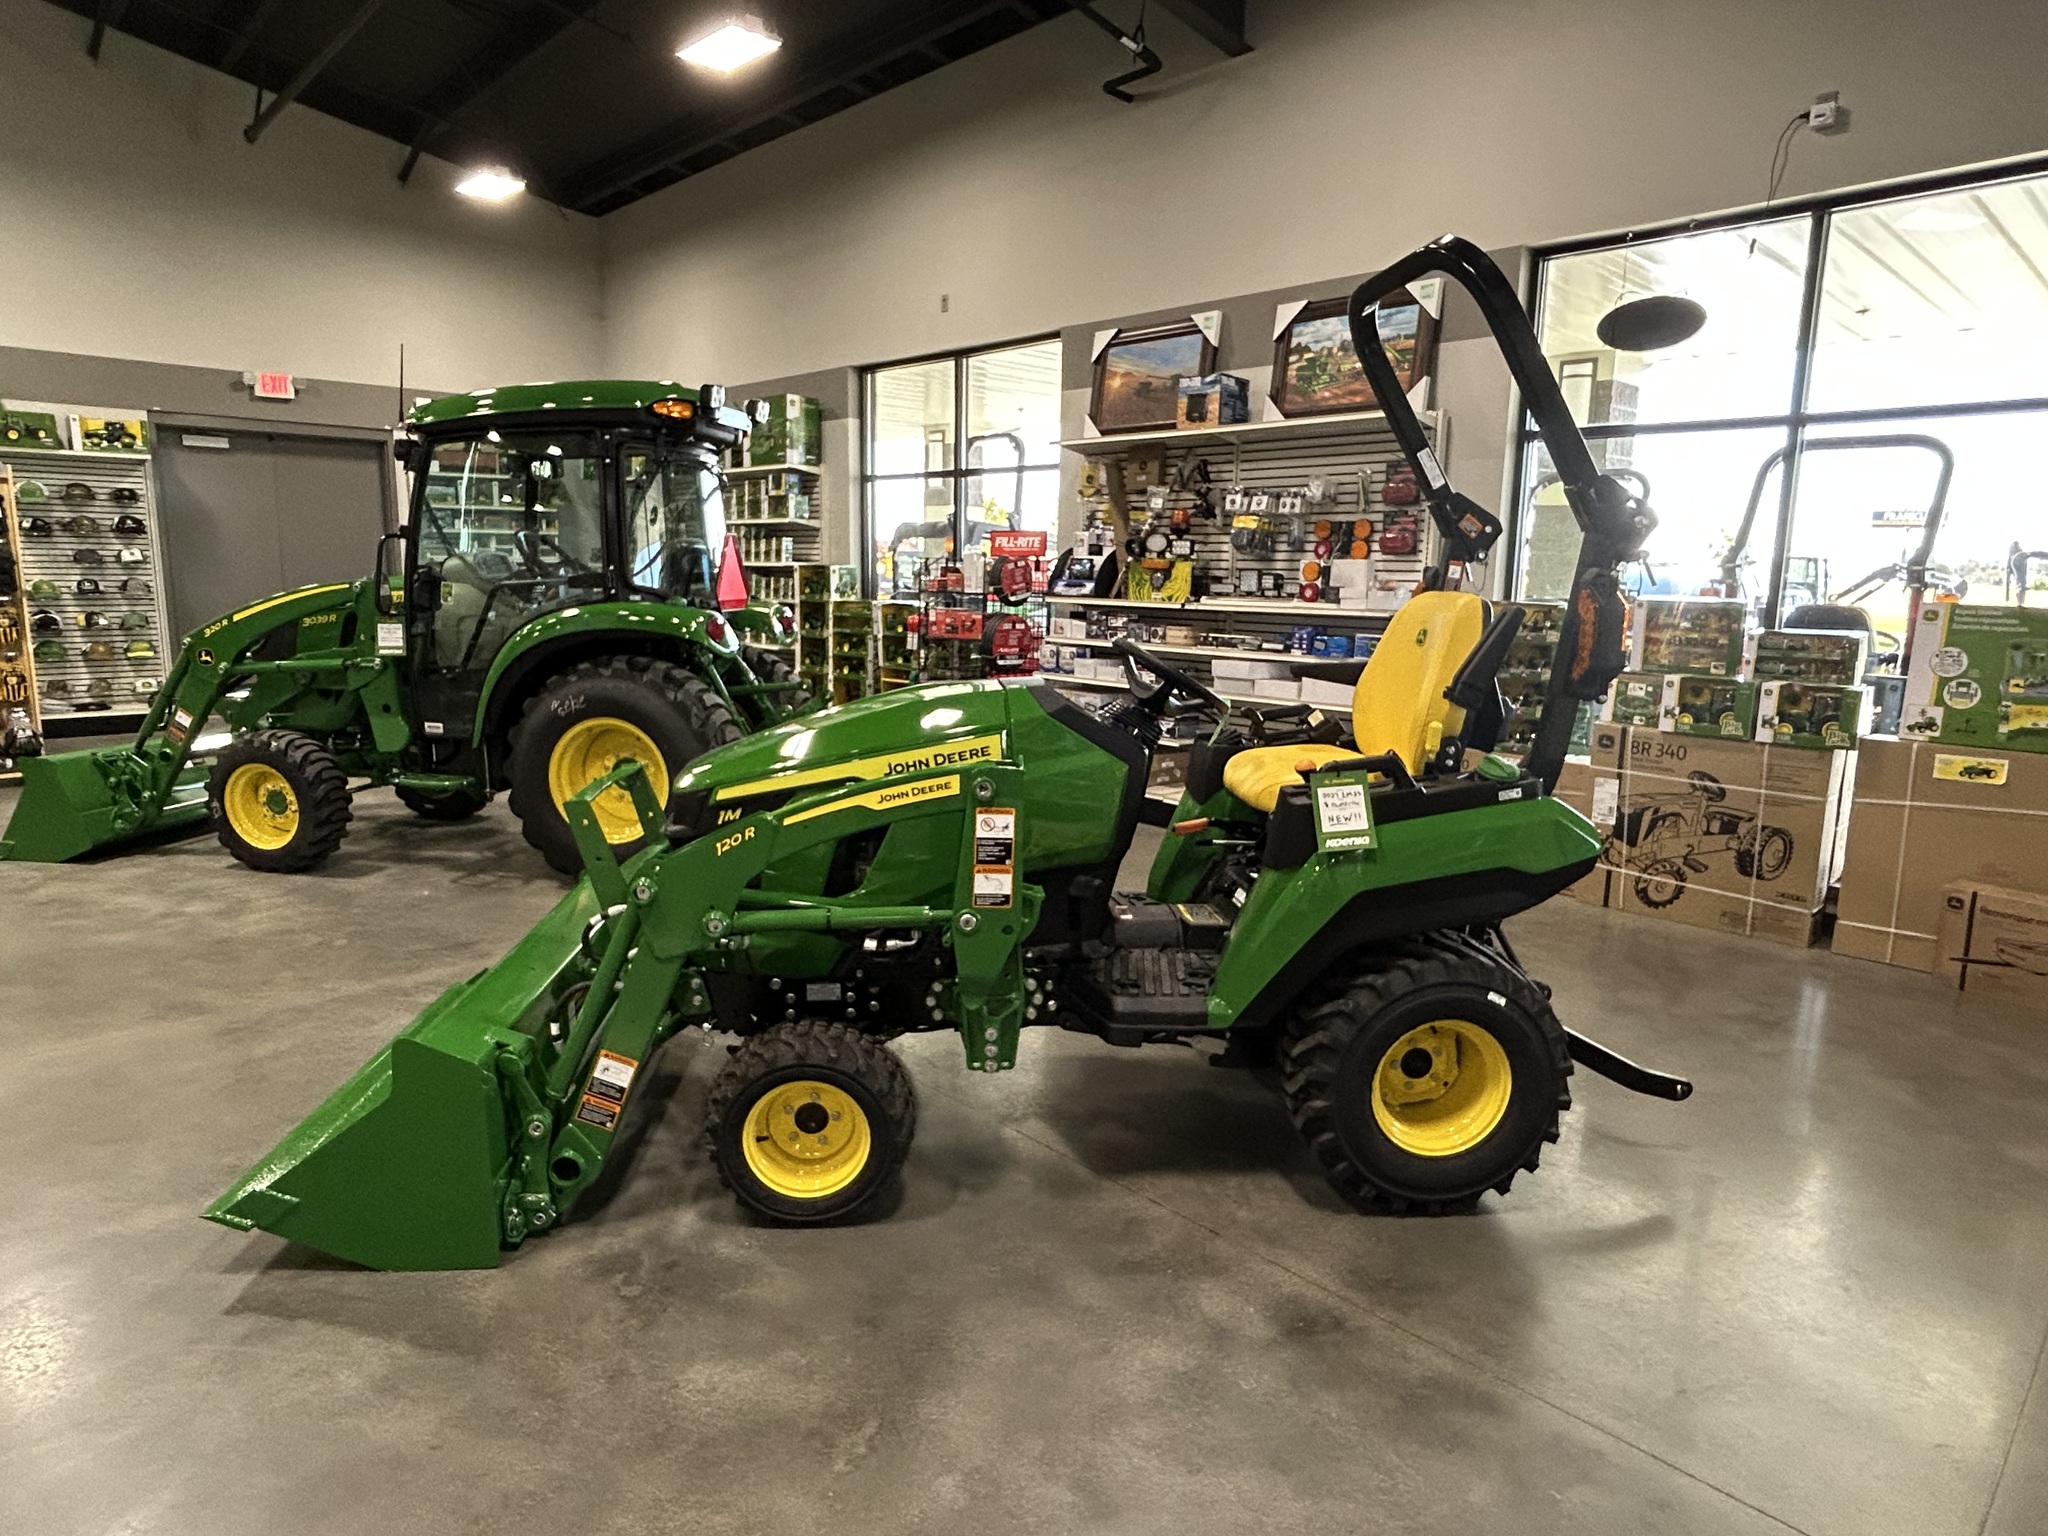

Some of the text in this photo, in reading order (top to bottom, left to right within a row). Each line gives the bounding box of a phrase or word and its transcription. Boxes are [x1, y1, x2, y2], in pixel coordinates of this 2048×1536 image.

[261, 373, 288, 395] EXIT
[995, 536, 1041, 548] FILL-RITE
[204, 618, 229, 637] 320 R
[302, 613, 337, 627] 3039 R
[1630, 740, 1688, 761] BR 340
[884, 746, 992, 777] JOHN DEERE
[877, 781, 952, 804] JOHN DEERE
[717, 807, 743, 825] 1M
[715, 826, 756, 857] 120 R
